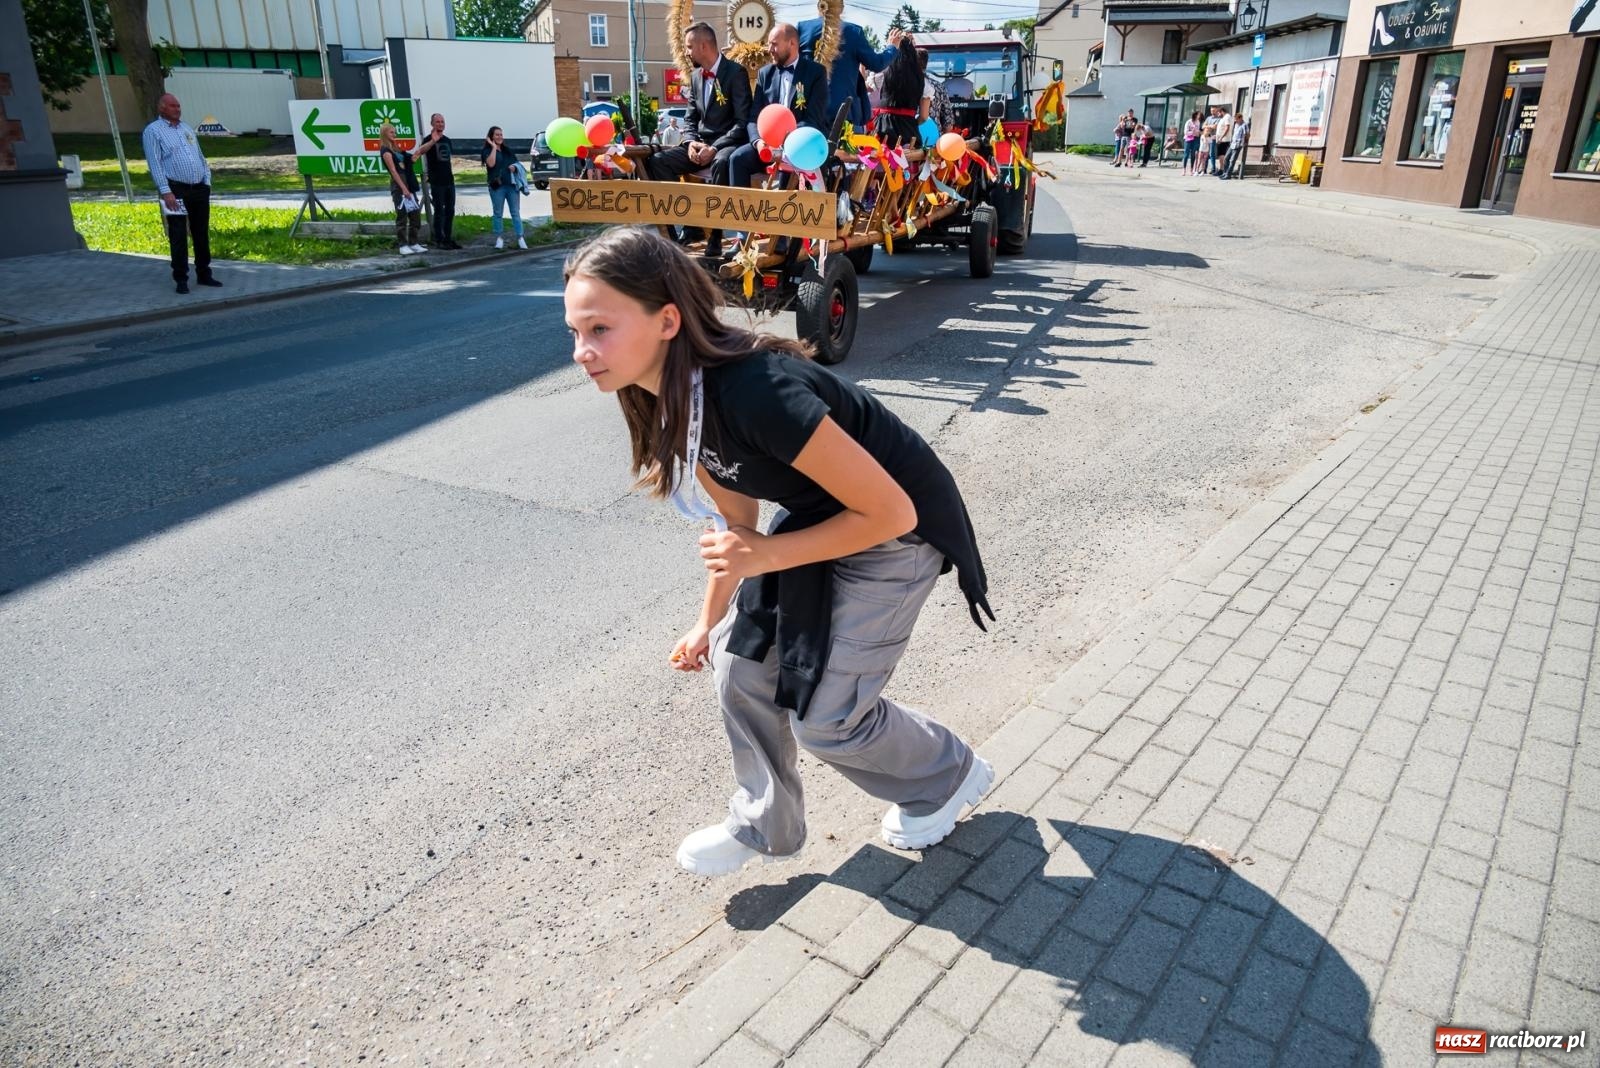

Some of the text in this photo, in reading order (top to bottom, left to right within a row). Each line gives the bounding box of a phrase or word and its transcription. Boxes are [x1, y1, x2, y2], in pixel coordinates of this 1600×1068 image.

[739, 16, 763, 29] IHS
[1404, 22, 1448, 39] & OBUWIE
[365, 124, 412, 135] stotka
[556, 187, 825, 226] SOŁECTWO PAWŁÓW
